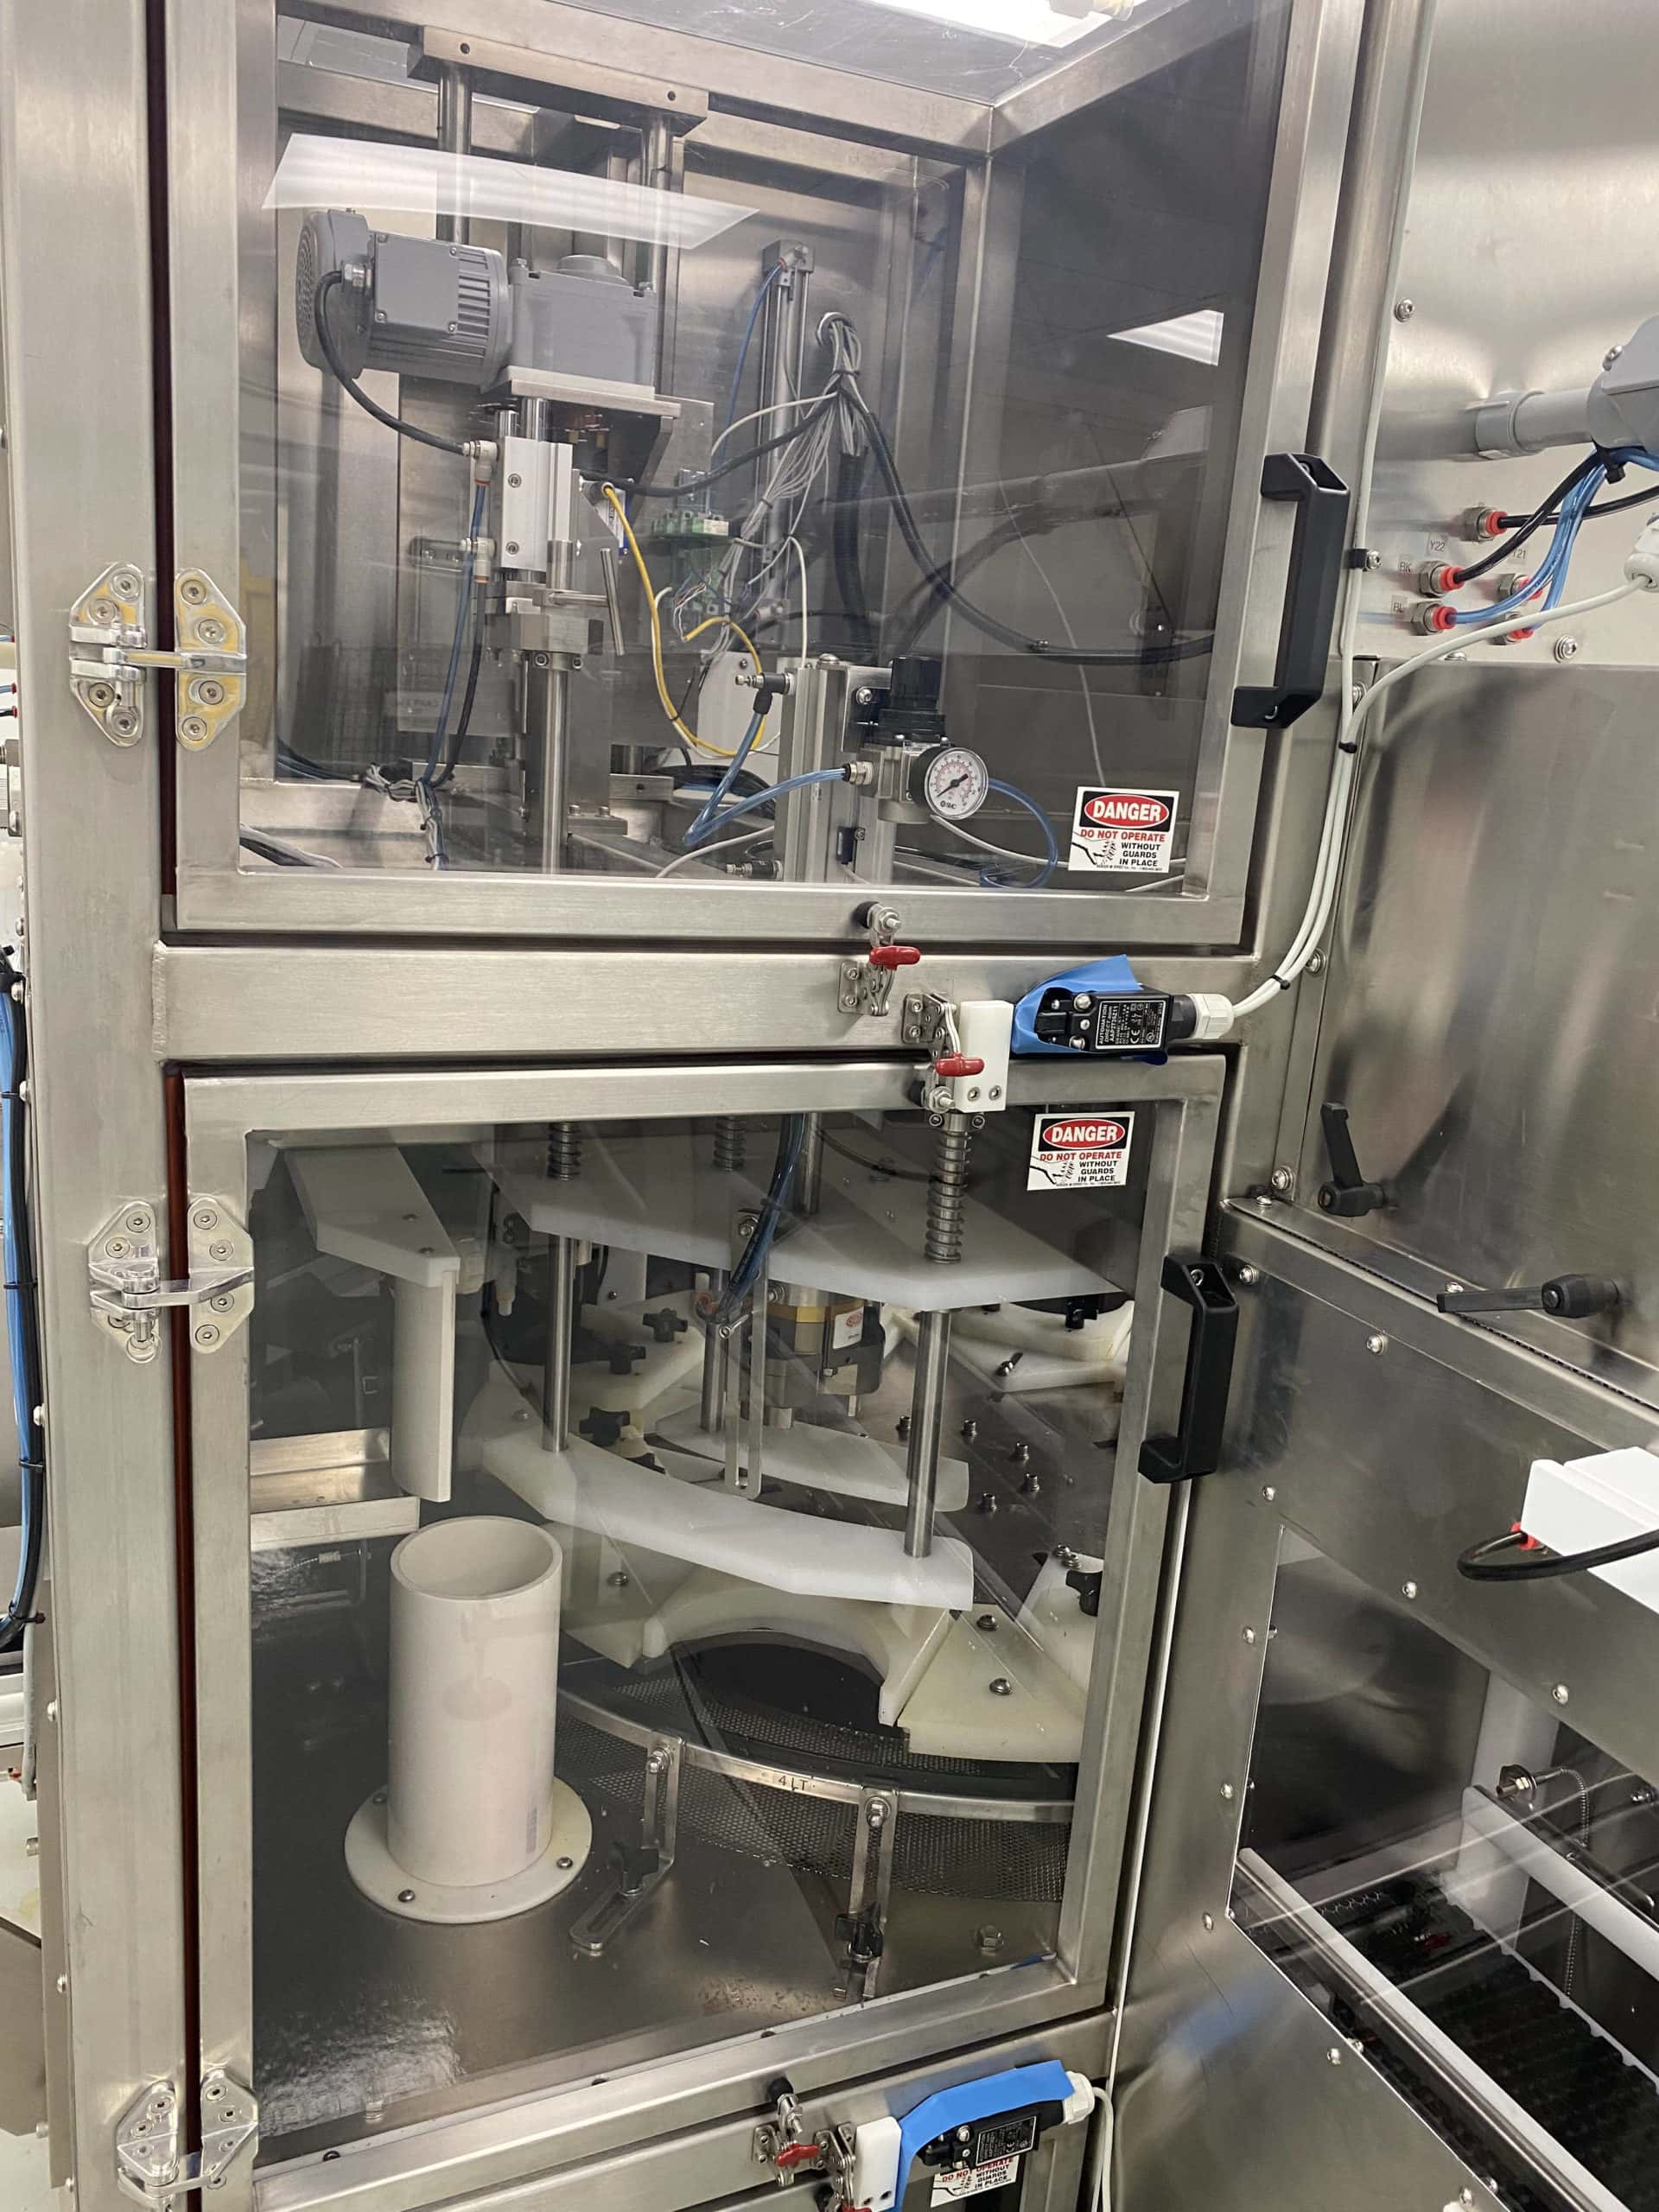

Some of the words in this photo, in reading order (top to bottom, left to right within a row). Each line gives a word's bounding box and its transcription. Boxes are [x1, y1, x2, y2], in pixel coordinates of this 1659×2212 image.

[1430, 540, 1446, 552] Y22
[1093, 800, 1161, 822] DANGER
[1080, 829, 1094, 838] DO
[1097, 830, 1118, 839] NOT
[1121, 831, 1166, 842] OPERATE
[1122, 842, 1161, 850] WITHOUT
[1051, 1125, 1118, 1142] DANGER
[1078, 1151, 1122, 1160] OPERATE
[942, 2174, 954, 2183] DO
[957, 2169, 973, 2179] NOT
[976, 2164, 1010, 2177] WITHOUT
[977, 2171, 1007, 2183] GUARDS
[985, 2175, 1008, 2186] PLACE
